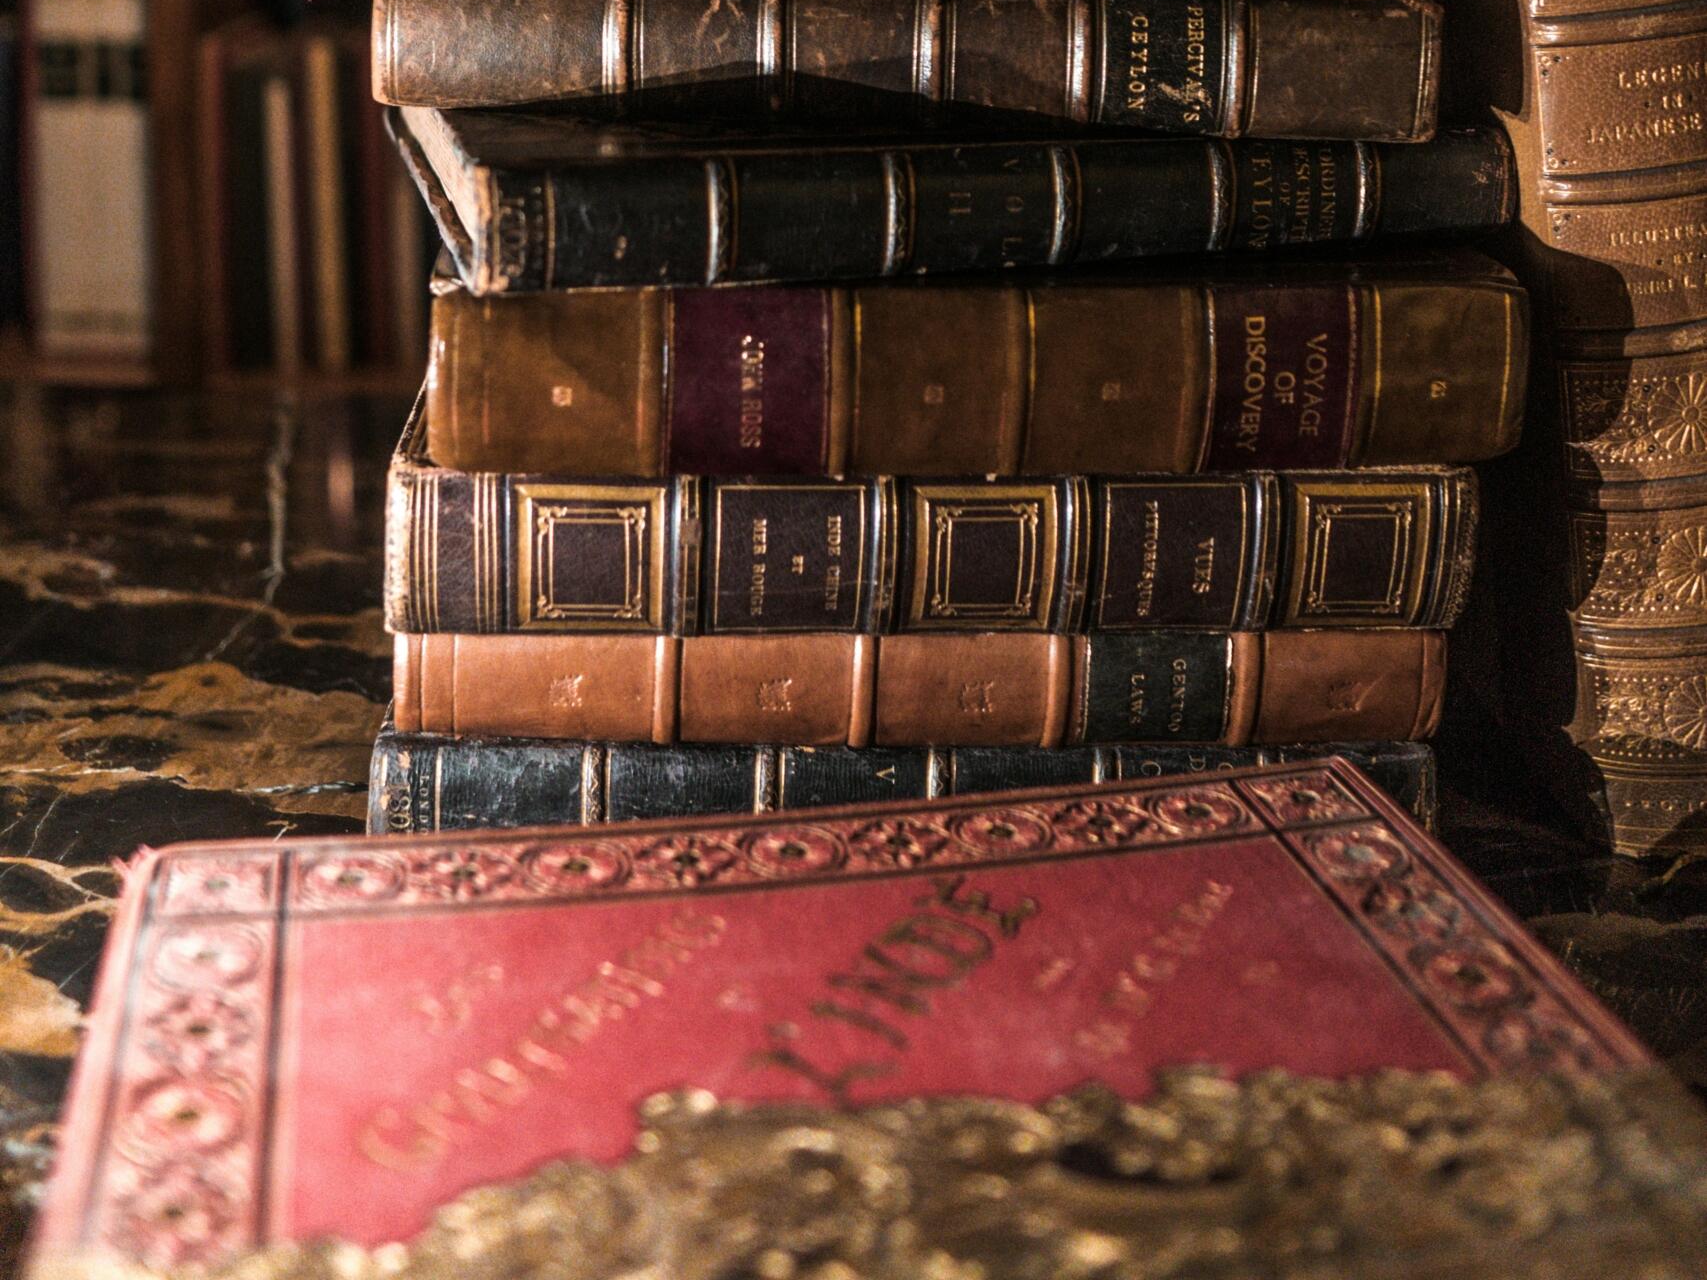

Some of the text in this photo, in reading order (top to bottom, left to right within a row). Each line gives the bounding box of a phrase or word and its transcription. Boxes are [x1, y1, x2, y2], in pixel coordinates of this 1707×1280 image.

[1126, 14, 1150, 112] CEYLON
[1182, 5, 1206, 124] PERCIVAL'S
[1617, 62, 1707, 90] LEGEN
[1585, 112, 1703, 144] JAPANESE
[1661, 92, 1684, 110] IN
[1235, 315, 1267, 453] DISCOVERY
[1273, 370, 1297, 406] OF
[1297, 332, 1328, 437] VOYAGE
[739, 398, 763, 449] ROSS
[826, 515, 842, 557] INDE
[1192, 536, 1215, 595] VUES
[1129, 672, 1146, 728] LAWS
[1167, 657, 1188, 733] GENTOO
